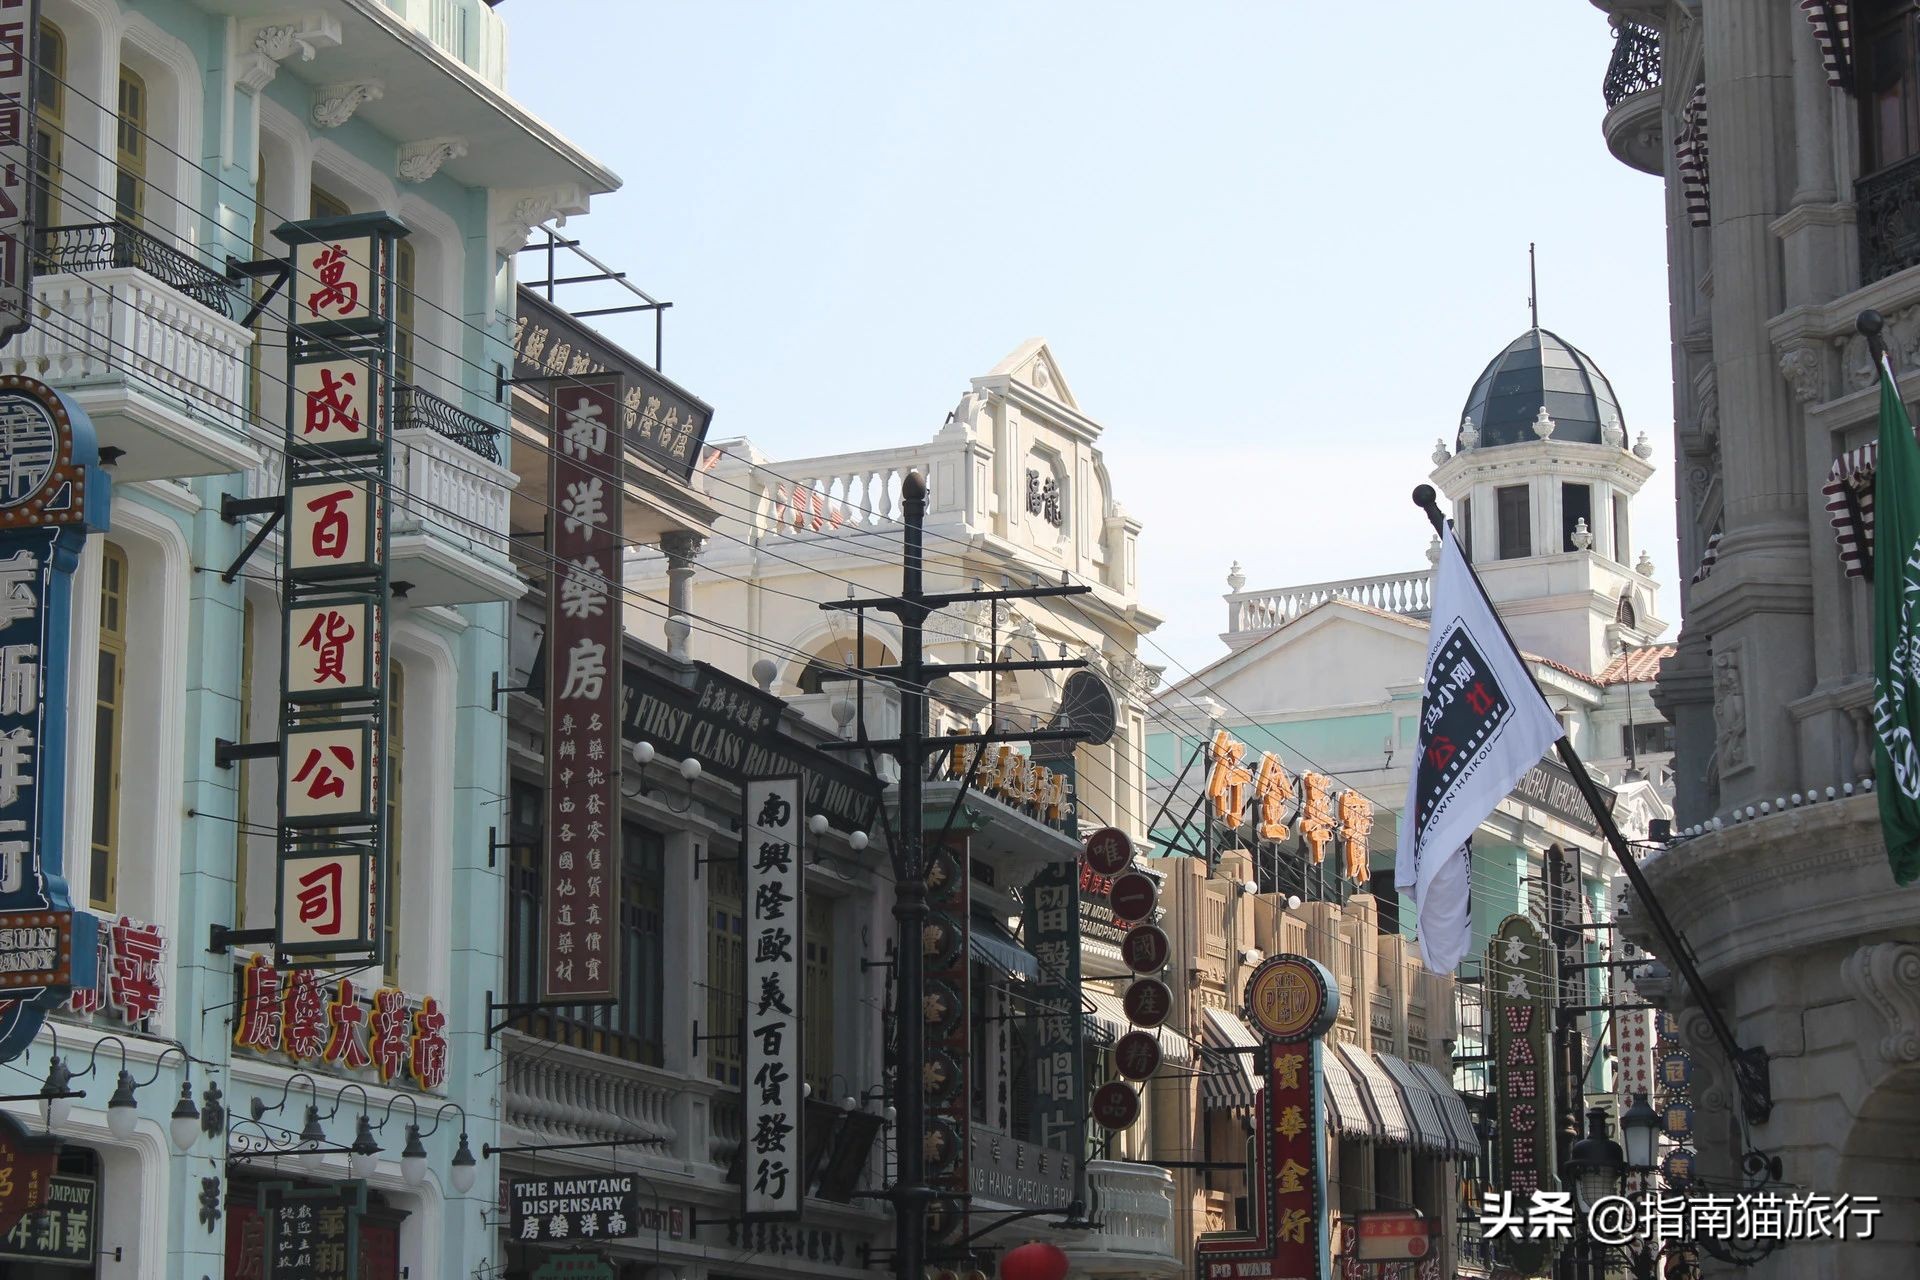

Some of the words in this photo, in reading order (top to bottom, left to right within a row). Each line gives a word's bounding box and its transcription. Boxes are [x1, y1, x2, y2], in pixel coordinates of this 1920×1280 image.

[561, 397, 608, 700] 南洋藥房
[291, 245, 359, 934] 萬成百貨公司
[1424, 656, 1475, 734] 冯小刚
[633, 694, 692, 745] FIRST
[692, 720, 744, 769] CLASS
[742, 743, 824, 804] BOARNG
[822, 779, 875, 825] HOUSE
[1515, 767, 1550, 802] ENERAL
[1091, 904, 1114, 922] MOON
[1274, 1053, 1311, 1244] 寶華金行
[515, 1182, 548, 1197] THE
[553, 1178, 631, 1195] NANTANG
[522, 1196, 624, 1215] DISPENSARY
[988, 1170, 1012, 1198] HANG
[1016, 1178, 1049, 1206] CHEONG
[316, 1206, 346, 1280] 華新
